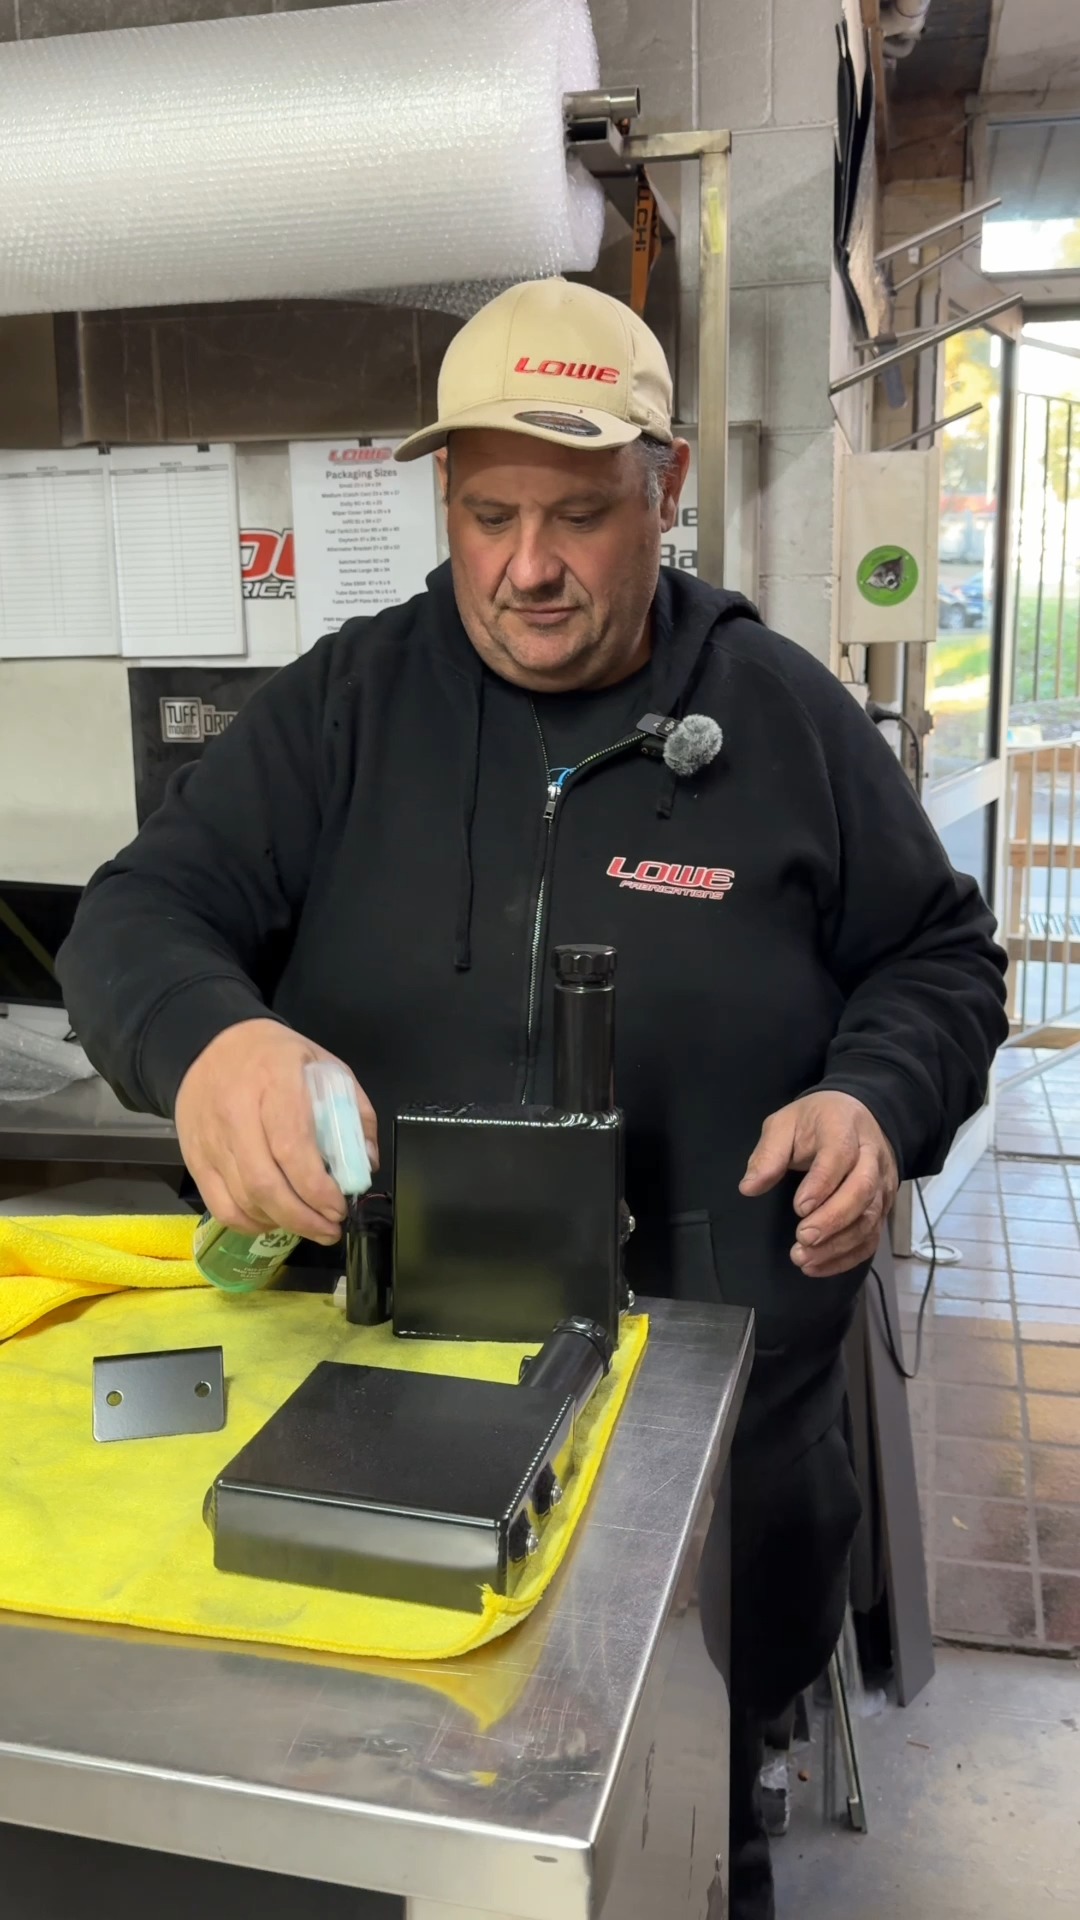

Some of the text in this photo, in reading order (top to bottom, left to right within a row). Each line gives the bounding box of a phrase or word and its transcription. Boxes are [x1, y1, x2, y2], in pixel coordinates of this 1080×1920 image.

[513, 357, 621, 385] LOWE
[325, 468, 398, 480] Packaging Sizes
[166, 705, 197, 724] TUFF
[606, 856, 735, 891] LOWE
